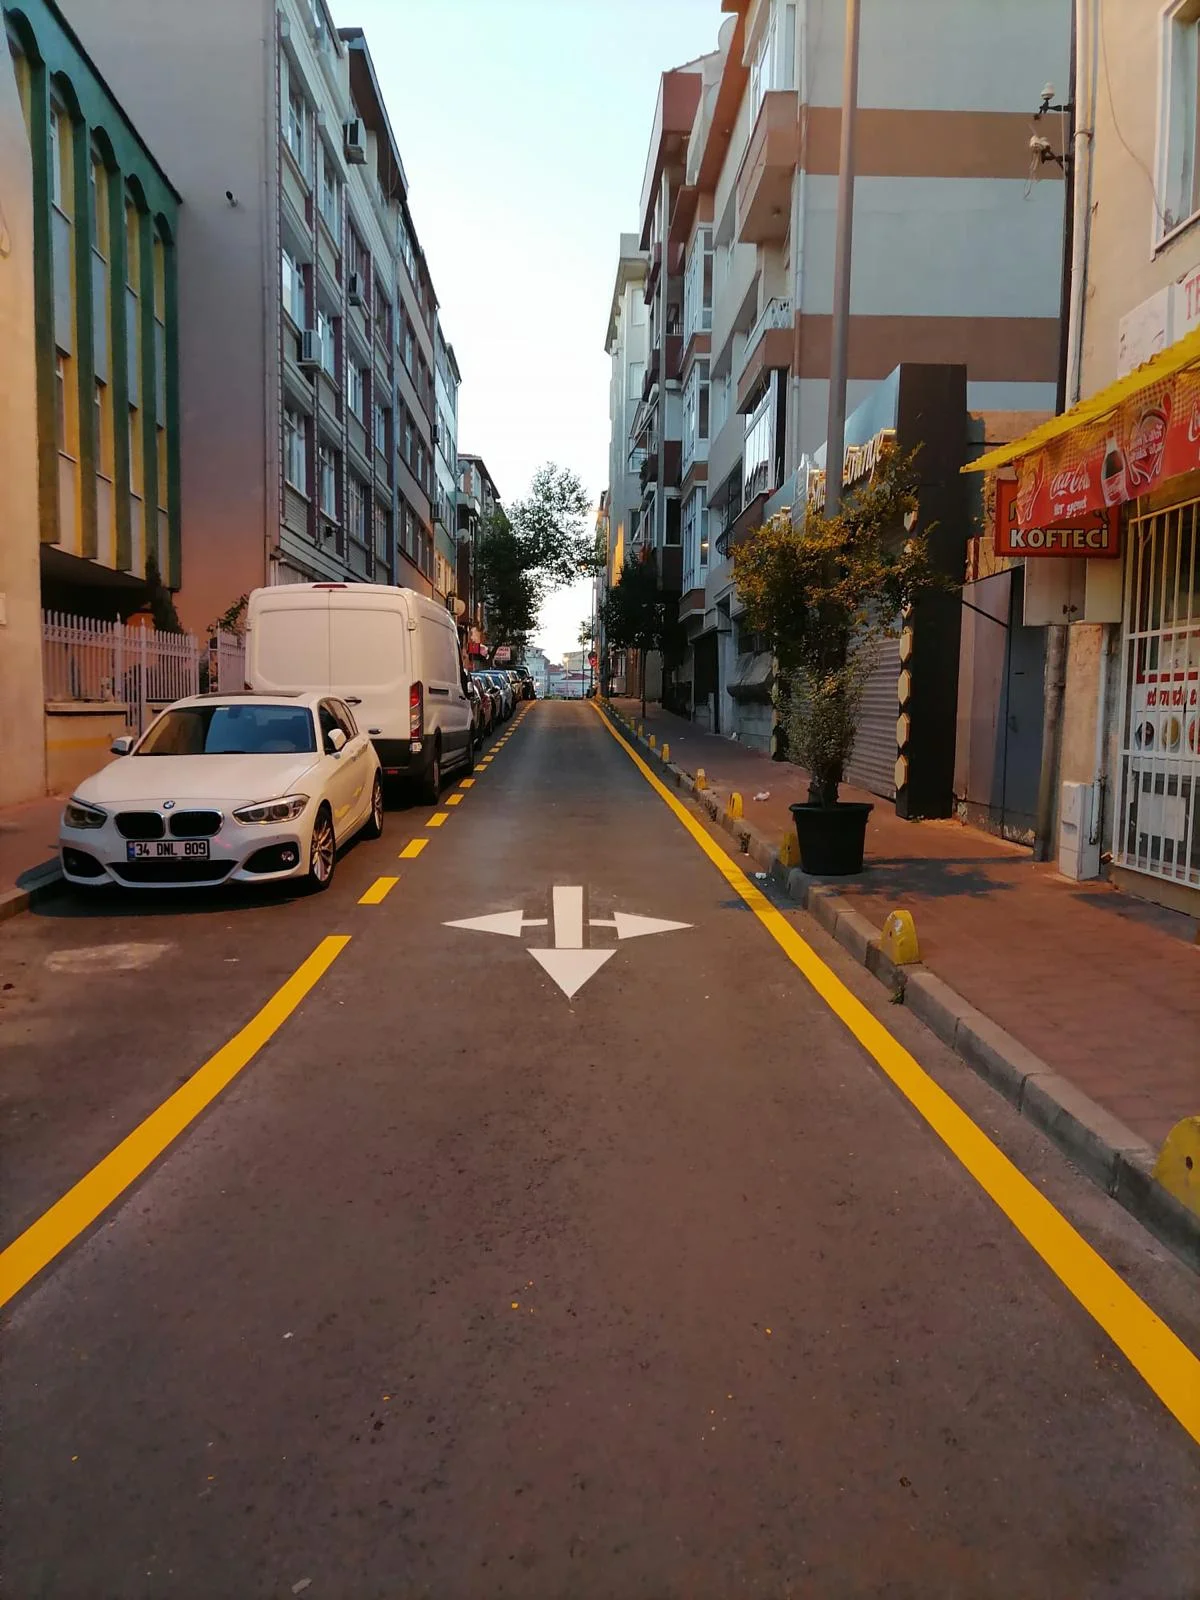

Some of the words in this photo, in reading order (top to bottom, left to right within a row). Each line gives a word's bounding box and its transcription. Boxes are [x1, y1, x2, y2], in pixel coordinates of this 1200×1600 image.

[135, 843, 150, 856] 34
[156, 843, 178, 856] DNL
[184, 842, 206, 855] 809
